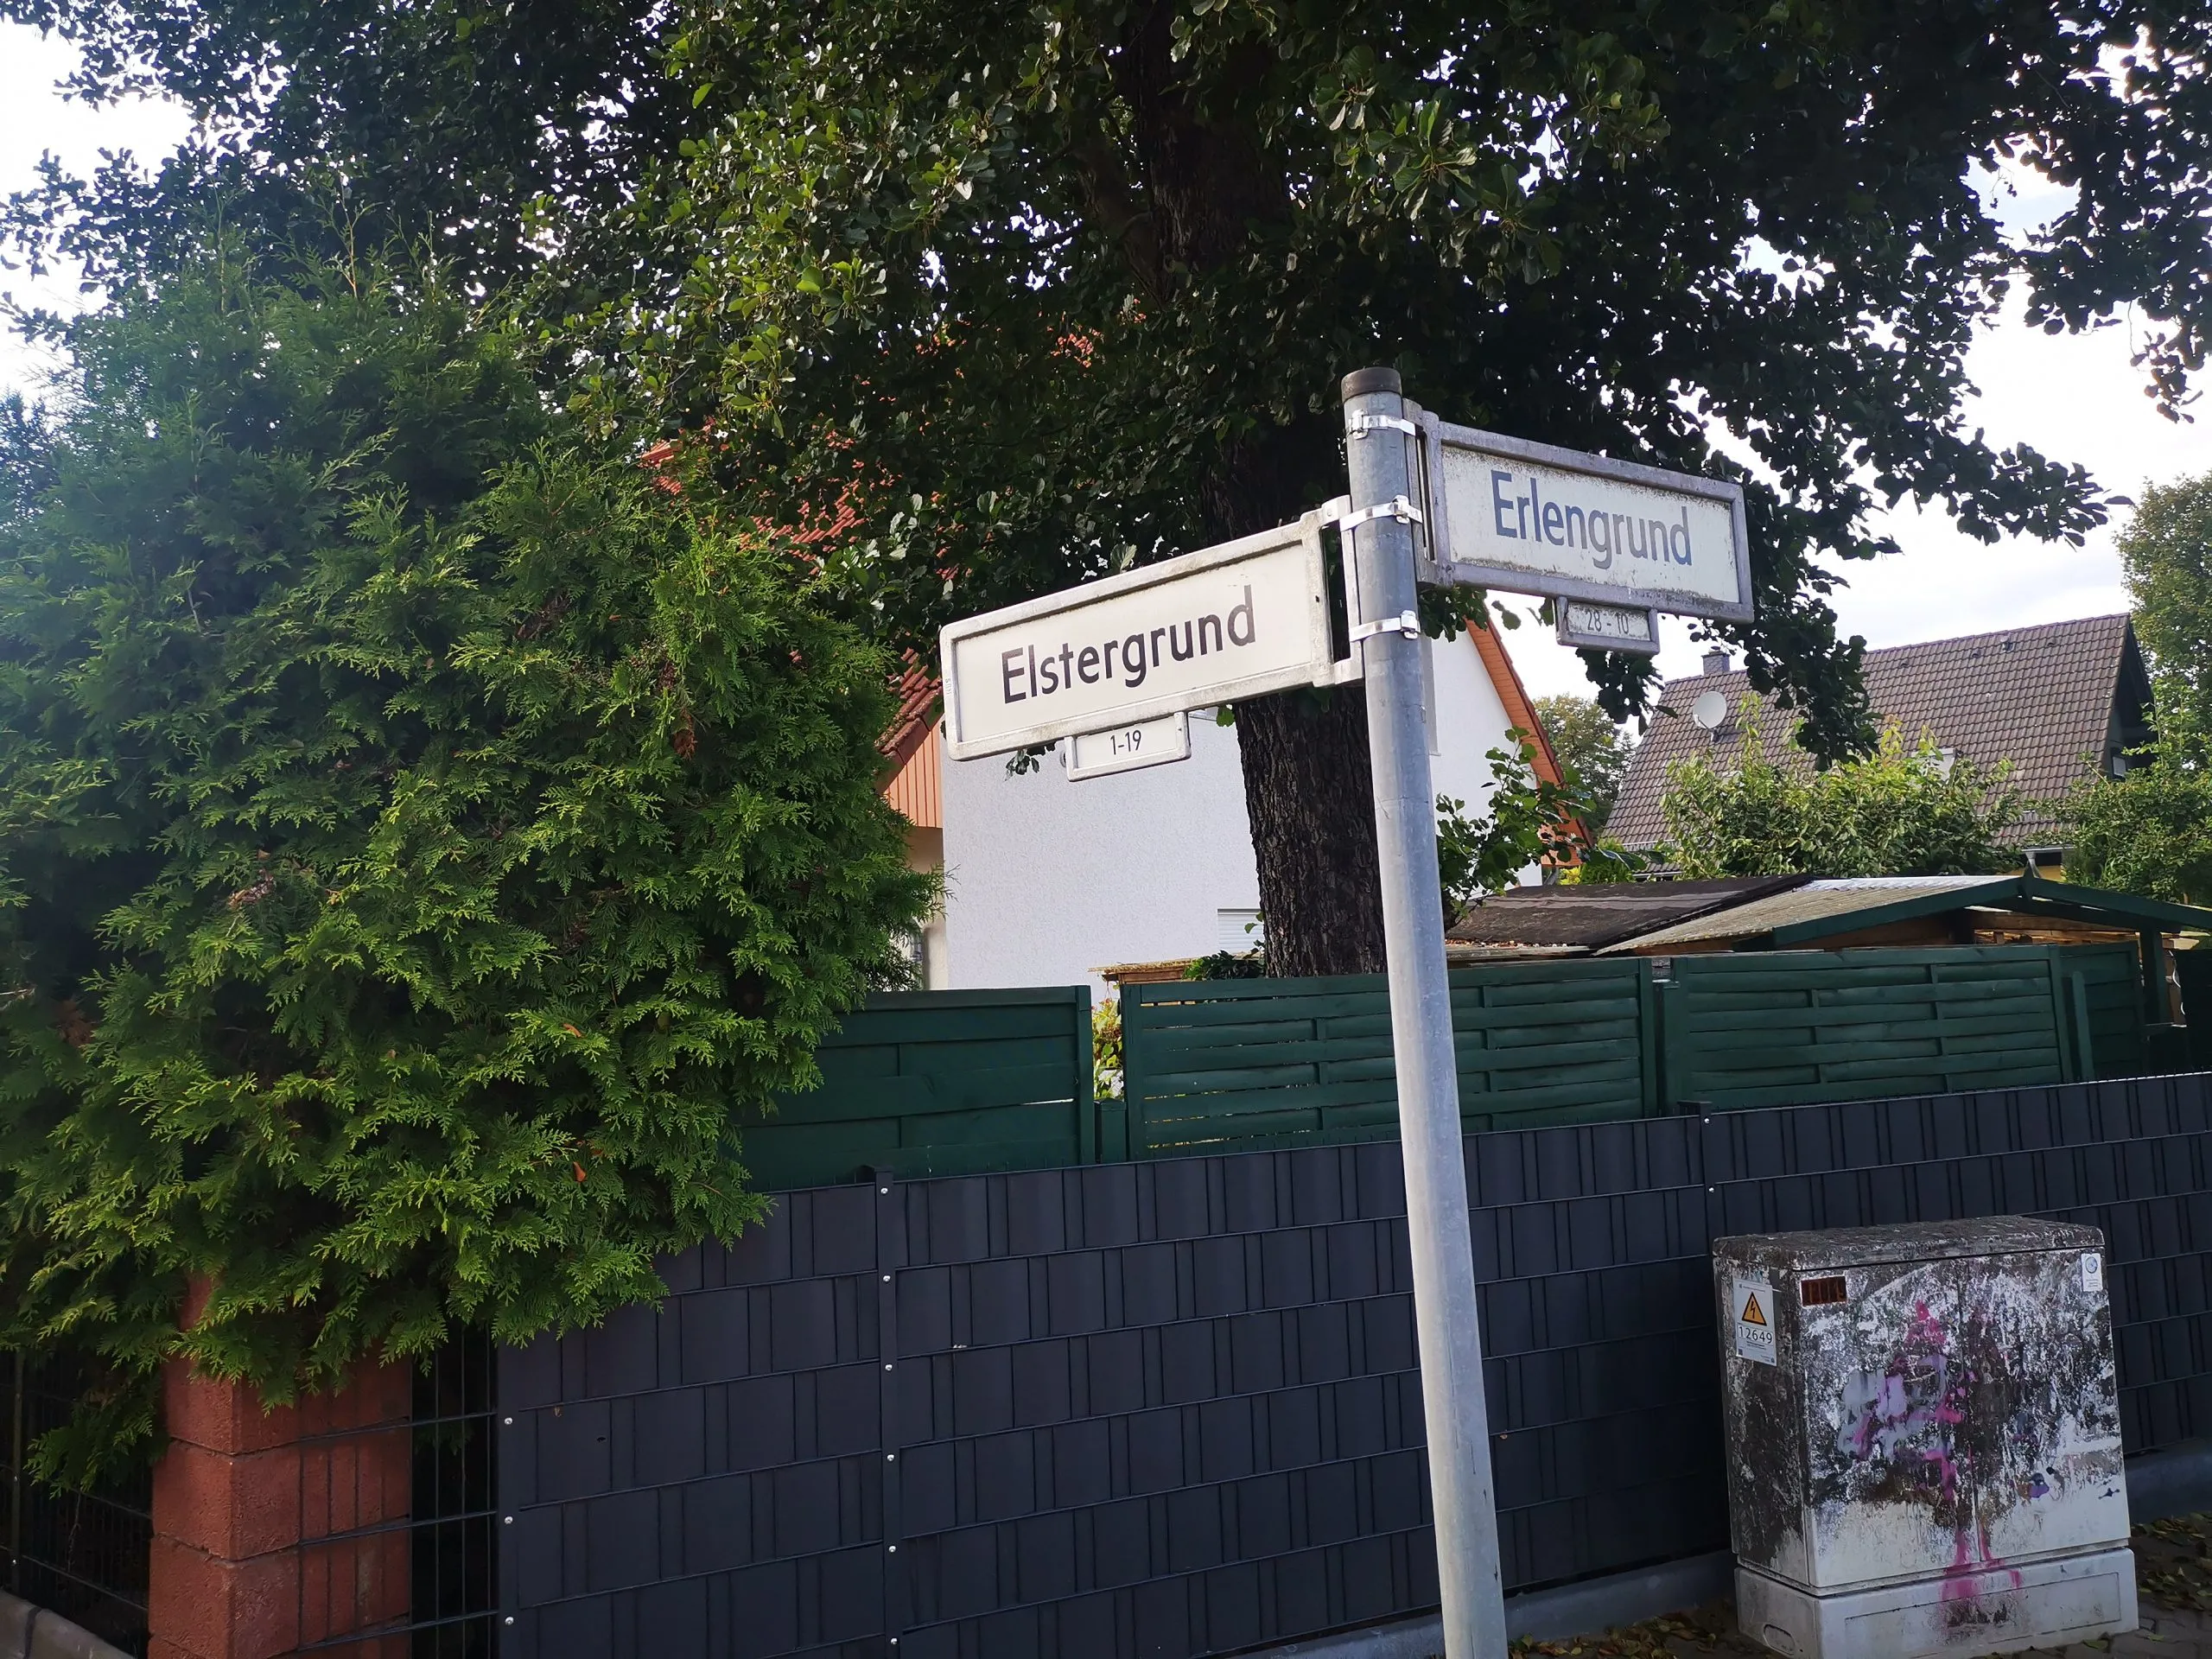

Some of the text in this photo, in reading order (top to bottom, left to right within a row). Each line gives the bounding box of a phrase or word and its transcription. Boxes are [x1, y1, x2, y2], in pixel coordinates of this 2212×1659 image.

[1491, 469, 1693, 569] Erlengrund
[1001, 584, 1256, 704] Elstergrund
[1110, 729, 1141, 755] 1-19
[1738, 1325, 1773, 1344] 12649
